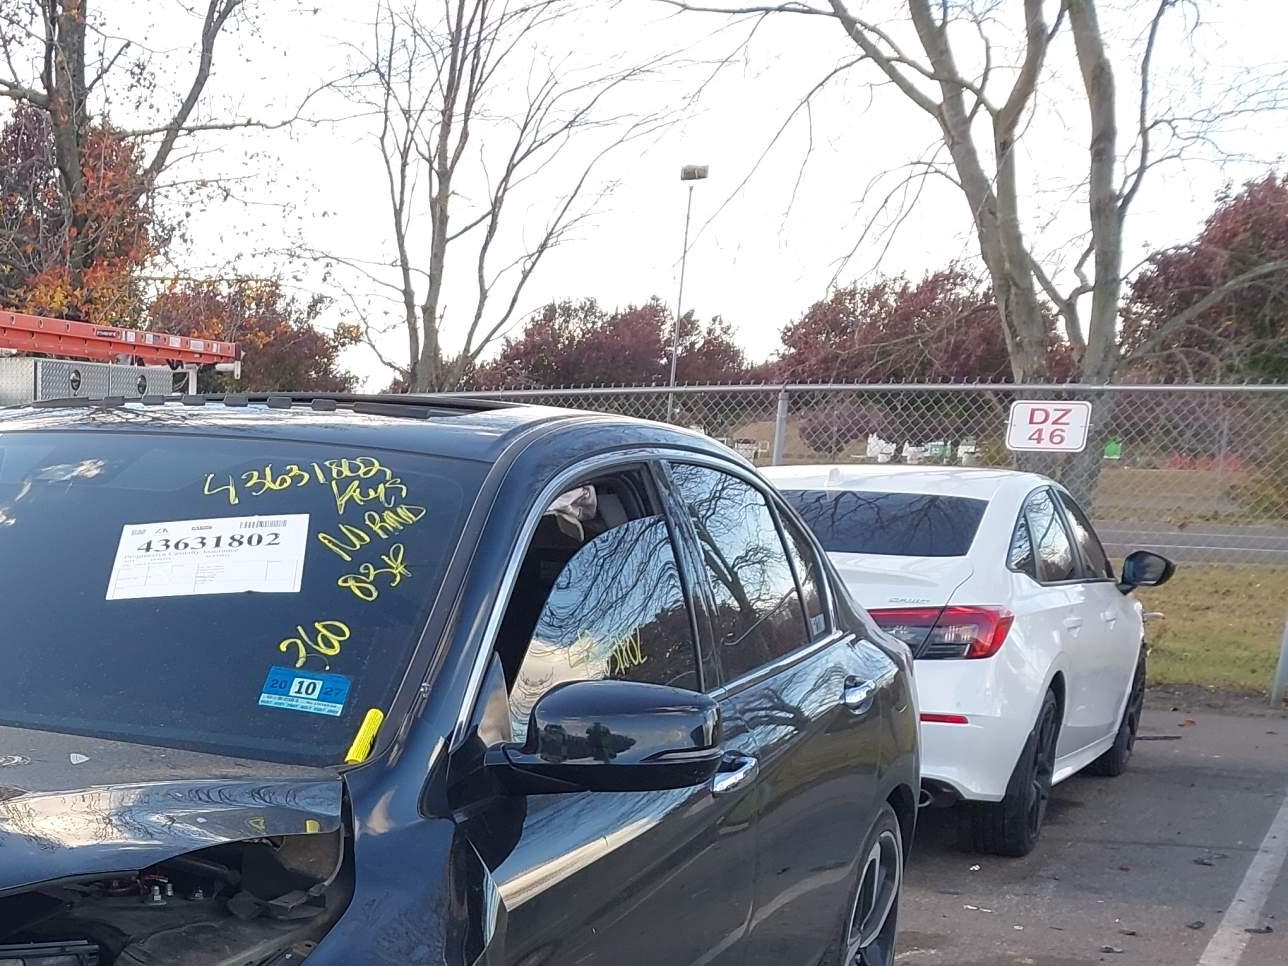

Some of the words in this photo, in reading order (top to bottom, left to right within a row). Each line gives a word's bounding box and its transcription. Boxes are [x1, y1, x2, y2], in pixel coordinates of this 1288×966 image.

[1028, 407, 1073, 426] DZ
[1027, 427, 1067, 445] 46
[136, 531, 282, 554] 43631802
[269, 678, 288, 690] 20
[294, 680, 317, 696] 10
